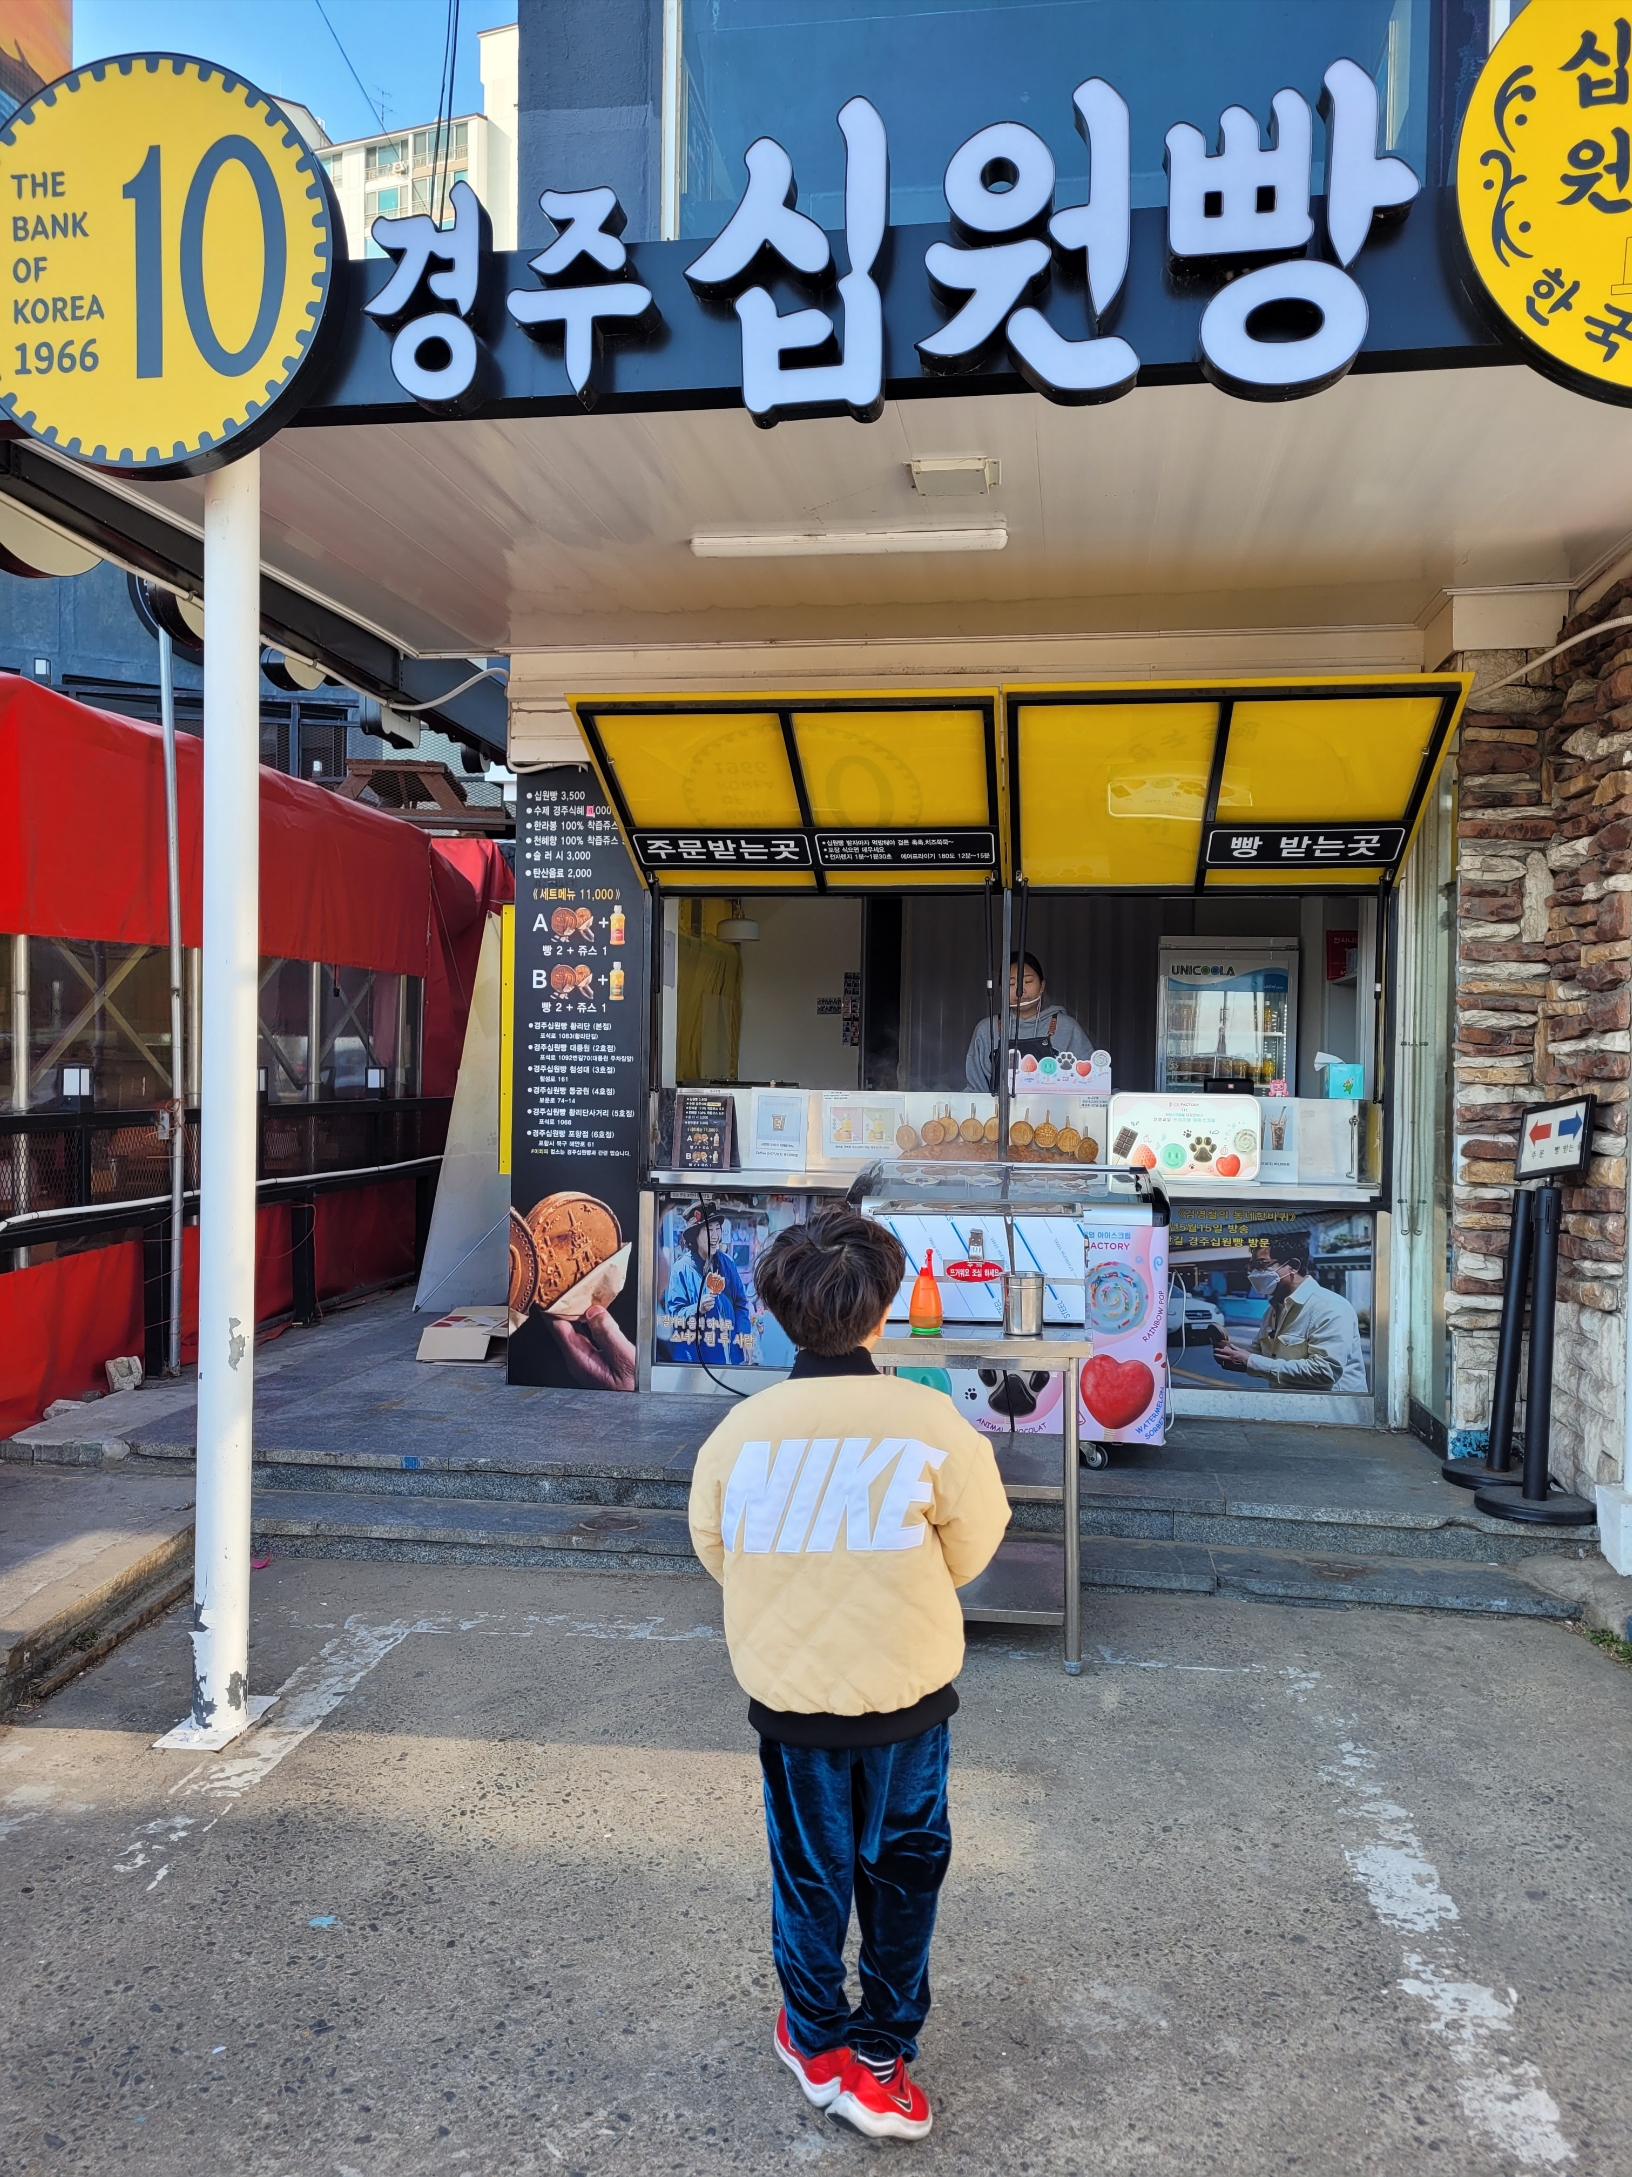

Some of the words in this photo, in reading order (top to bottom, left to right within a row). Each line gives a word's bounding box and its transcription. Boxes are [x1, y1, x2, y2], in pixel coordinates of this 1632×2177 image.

[10, 170, 66, 200] THE
[12, 210, 88, 242] BANK
[122, 134, 288, 380] 10
[12, 256, 48, 284] OF
[12, 292, 106, 326] KOREA
[12, 336, 100, 376] 1966
[534, 790, 558, 802] 십원빵
[560, 790, 586, 802] 3,500
[534, 806, 550, 816] 수제
[552, 806, 584, 816] 경주식혜
[534, 820, 558, 832] 한라봉
[560, 822, 584, 830] 100%
[587, 820, 618, 830] 착즙쥬스
[534, 836, 558, 846] 천혜향
[560, 836, 584, 846] 100%
[587, 836, 618, 846] 착즙쥬스
[1230, 836, 1263, 858] 빵
[1280, 834, 1381, 858] 받는곳
[566, 850, 591, 862] 3,000
[646, 838, 800, 862] 주문받는곳
[532, 868, 564, 878] 탄산음료
[568, 868, 592, 878] 2,000
[532, 913, 548, 932] A
[542, 944, 552, 956] 빵
[556, 946, 563, 956] 2
[578, 945, 598, 956] 쥬스
[602, 946, 607, 956] 1
[532, 970, 548, 988] B
[541, 1002, 552, 1014] 빵
[556, 1002, 562, 1012] 2
[576, 1002, 597, 1014] 쥬스
[601, 1003, 606, 1012] 1
[534, 1022, 568, 1030] 경주십원빵
[534, 1044, 568, 1052] 경주십원빵
[592, 1044, 616, 1052] (2호점)
[533, 1064, 567, 1074] 경주십원빵
[592, 1066, 616, 1074] (3호점)
[532, 1086, 567, 1095] 경주십원빵
[592, 1087, 616, 1096] (4호점)
[532, 1108, 566, 1116] 경주십원빵
[532, 1129, 566, 1138] 경주십원빵
[590, 1130, 615, 1139] (6호점)
[1228, 1224, 1250, 1234] 방송
[1097, 1231, 1132, 1240] 아이스크림
[1090, 1242, 1130, 1250] ACTORY
[1188, 1236, 1245, 1248] 경주십원빵
[1248, 1238, 1270, 1248] 방문
[972, 1268, 983, 1278] 조심
[1142, 1307, 1164, 1342] RAINBOW
[704, 1330, 716, 1348] 된
[717, 1331, 731, 1348] 두
[732, 1332, 755, 1350] 사람
[1134, 1386, 1165, 1434] WATERMELON
[720, 1436, 950, 1554] NIKE
